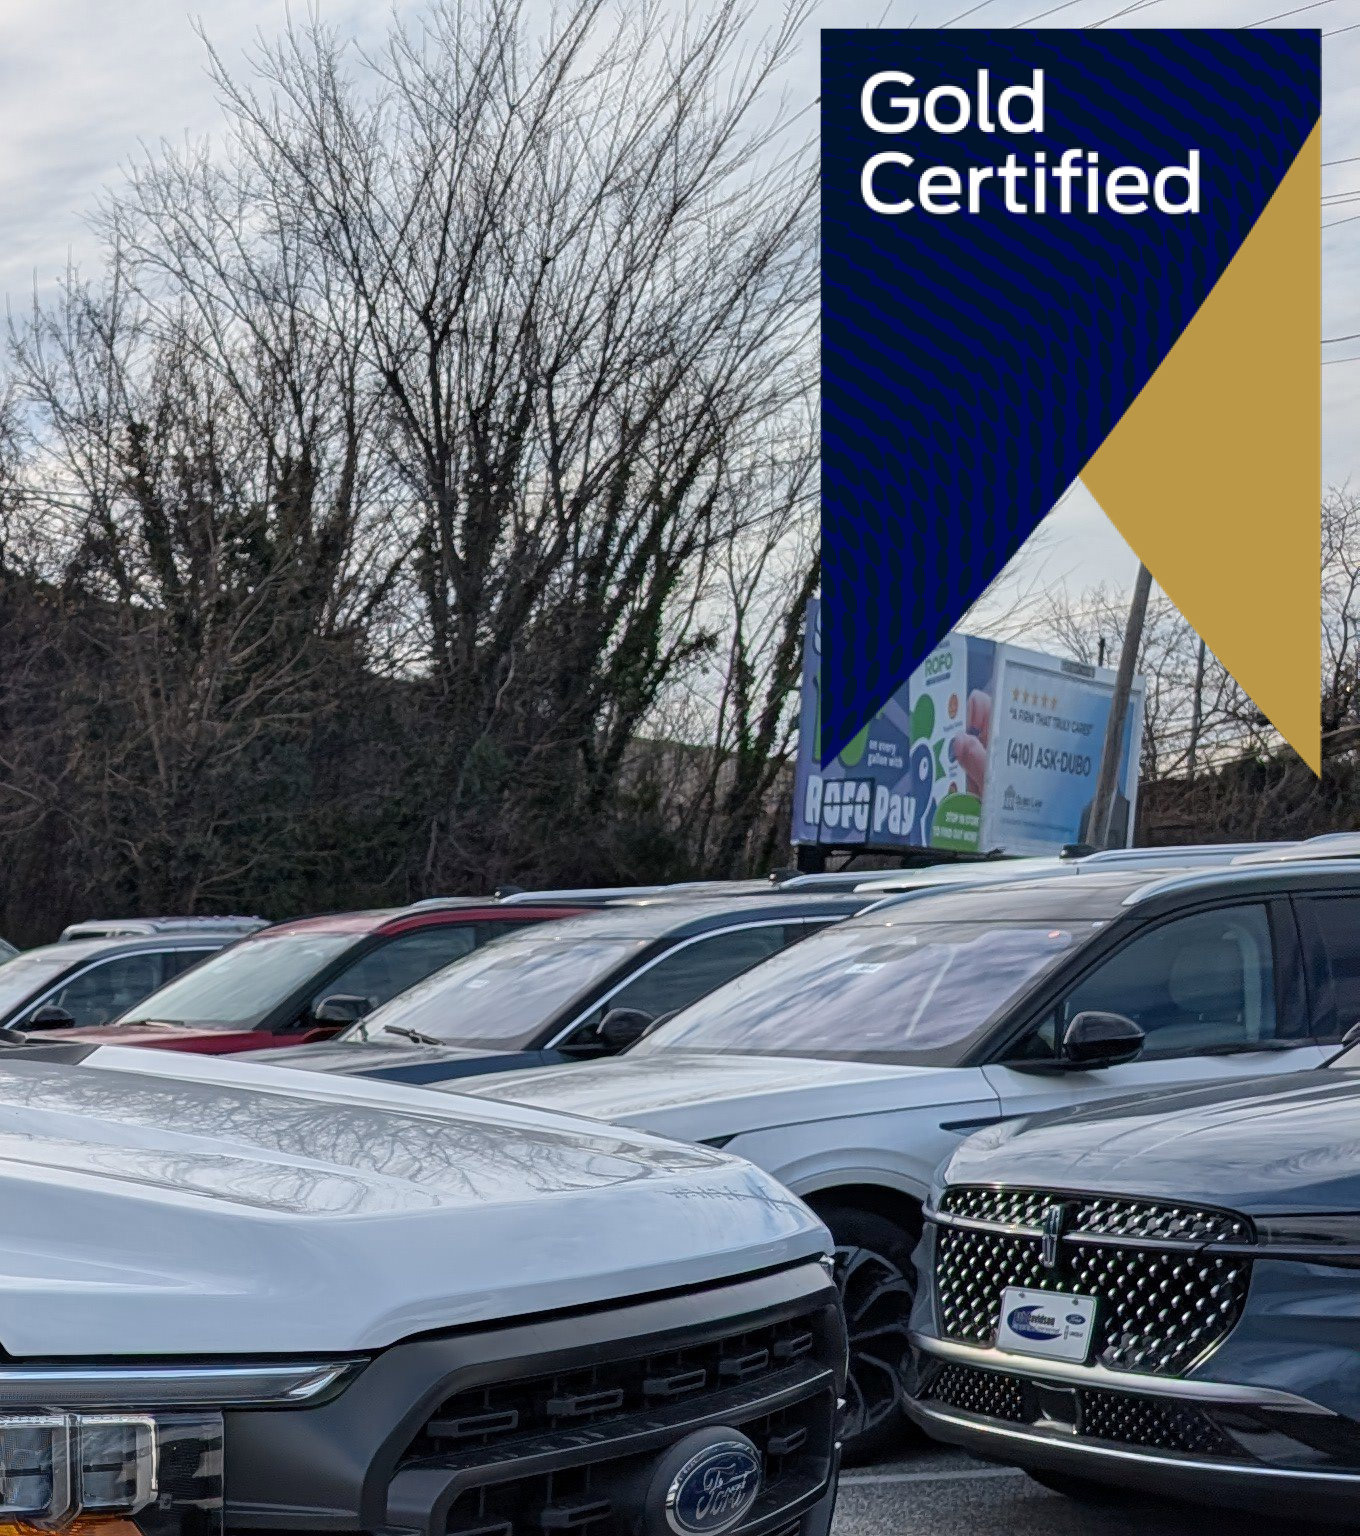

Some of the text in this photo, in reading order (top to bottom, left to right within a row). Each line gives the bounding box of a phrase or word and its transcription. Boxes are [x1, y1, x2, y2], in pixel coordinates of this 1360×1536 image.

[1007, 738, 1092, 777] (410) ASK-DUBO
[804, 774, 917, 836] ROFO Pay
[696, 1463, 750, 1520] Ford
